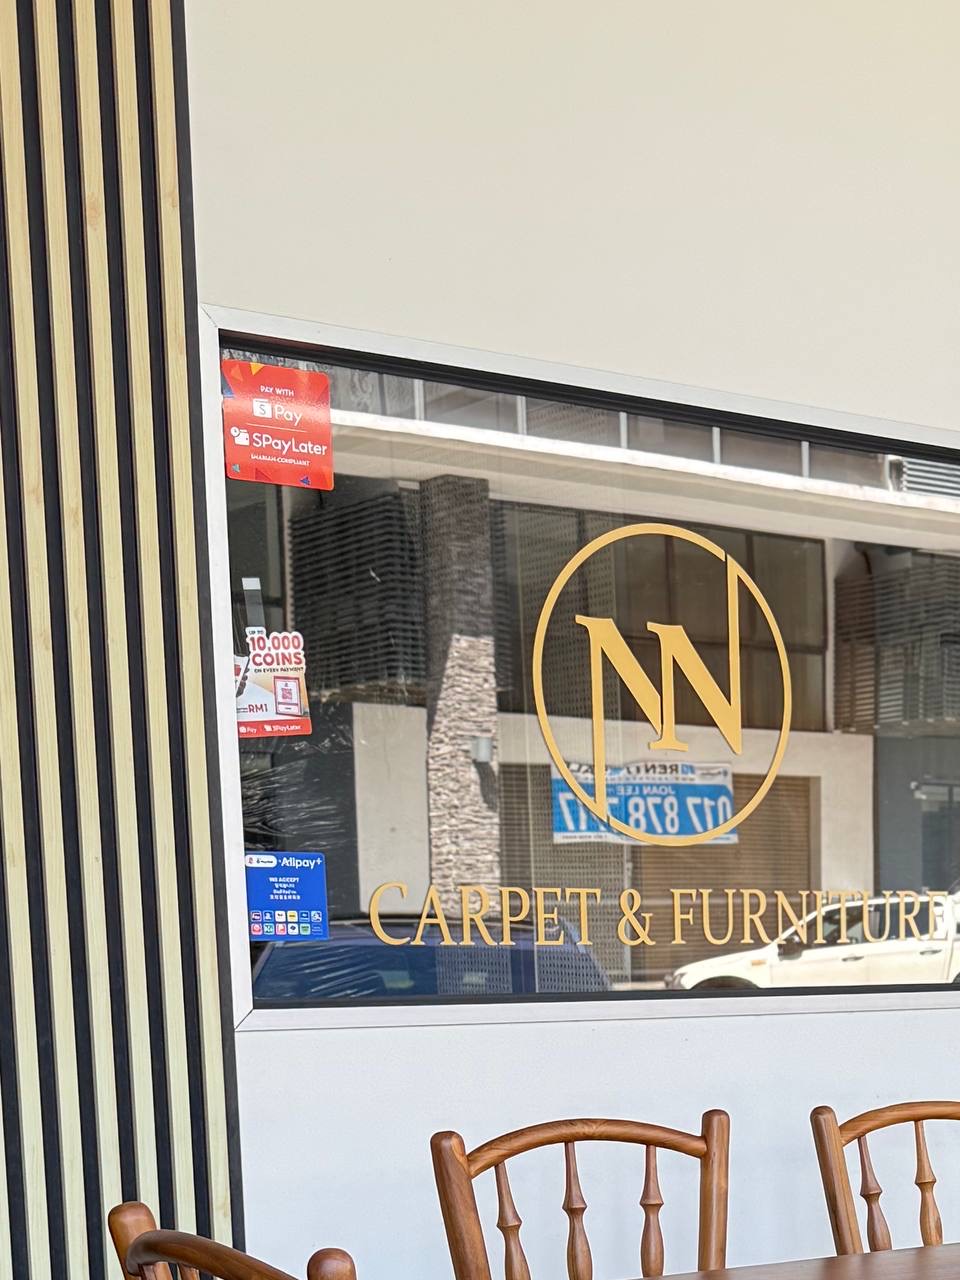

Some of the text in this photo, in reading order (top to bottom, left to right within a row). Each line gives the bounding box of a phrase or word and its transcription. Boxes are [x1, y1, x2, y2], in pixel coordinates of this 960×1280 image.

[260, 385, 294, 396] PAY WITH
[274, 404, 303, 427] Pay
[253, 433, 326, 455] SPayLater
[250, 635, 301, 651] 10,000
[252, 652, 302, 667] COINS
[248, 704, 268, 713] RM1
[281, 857, 322, 869] Alipay+
[368, 881, 950, 947] CARPET & FURNITURE
